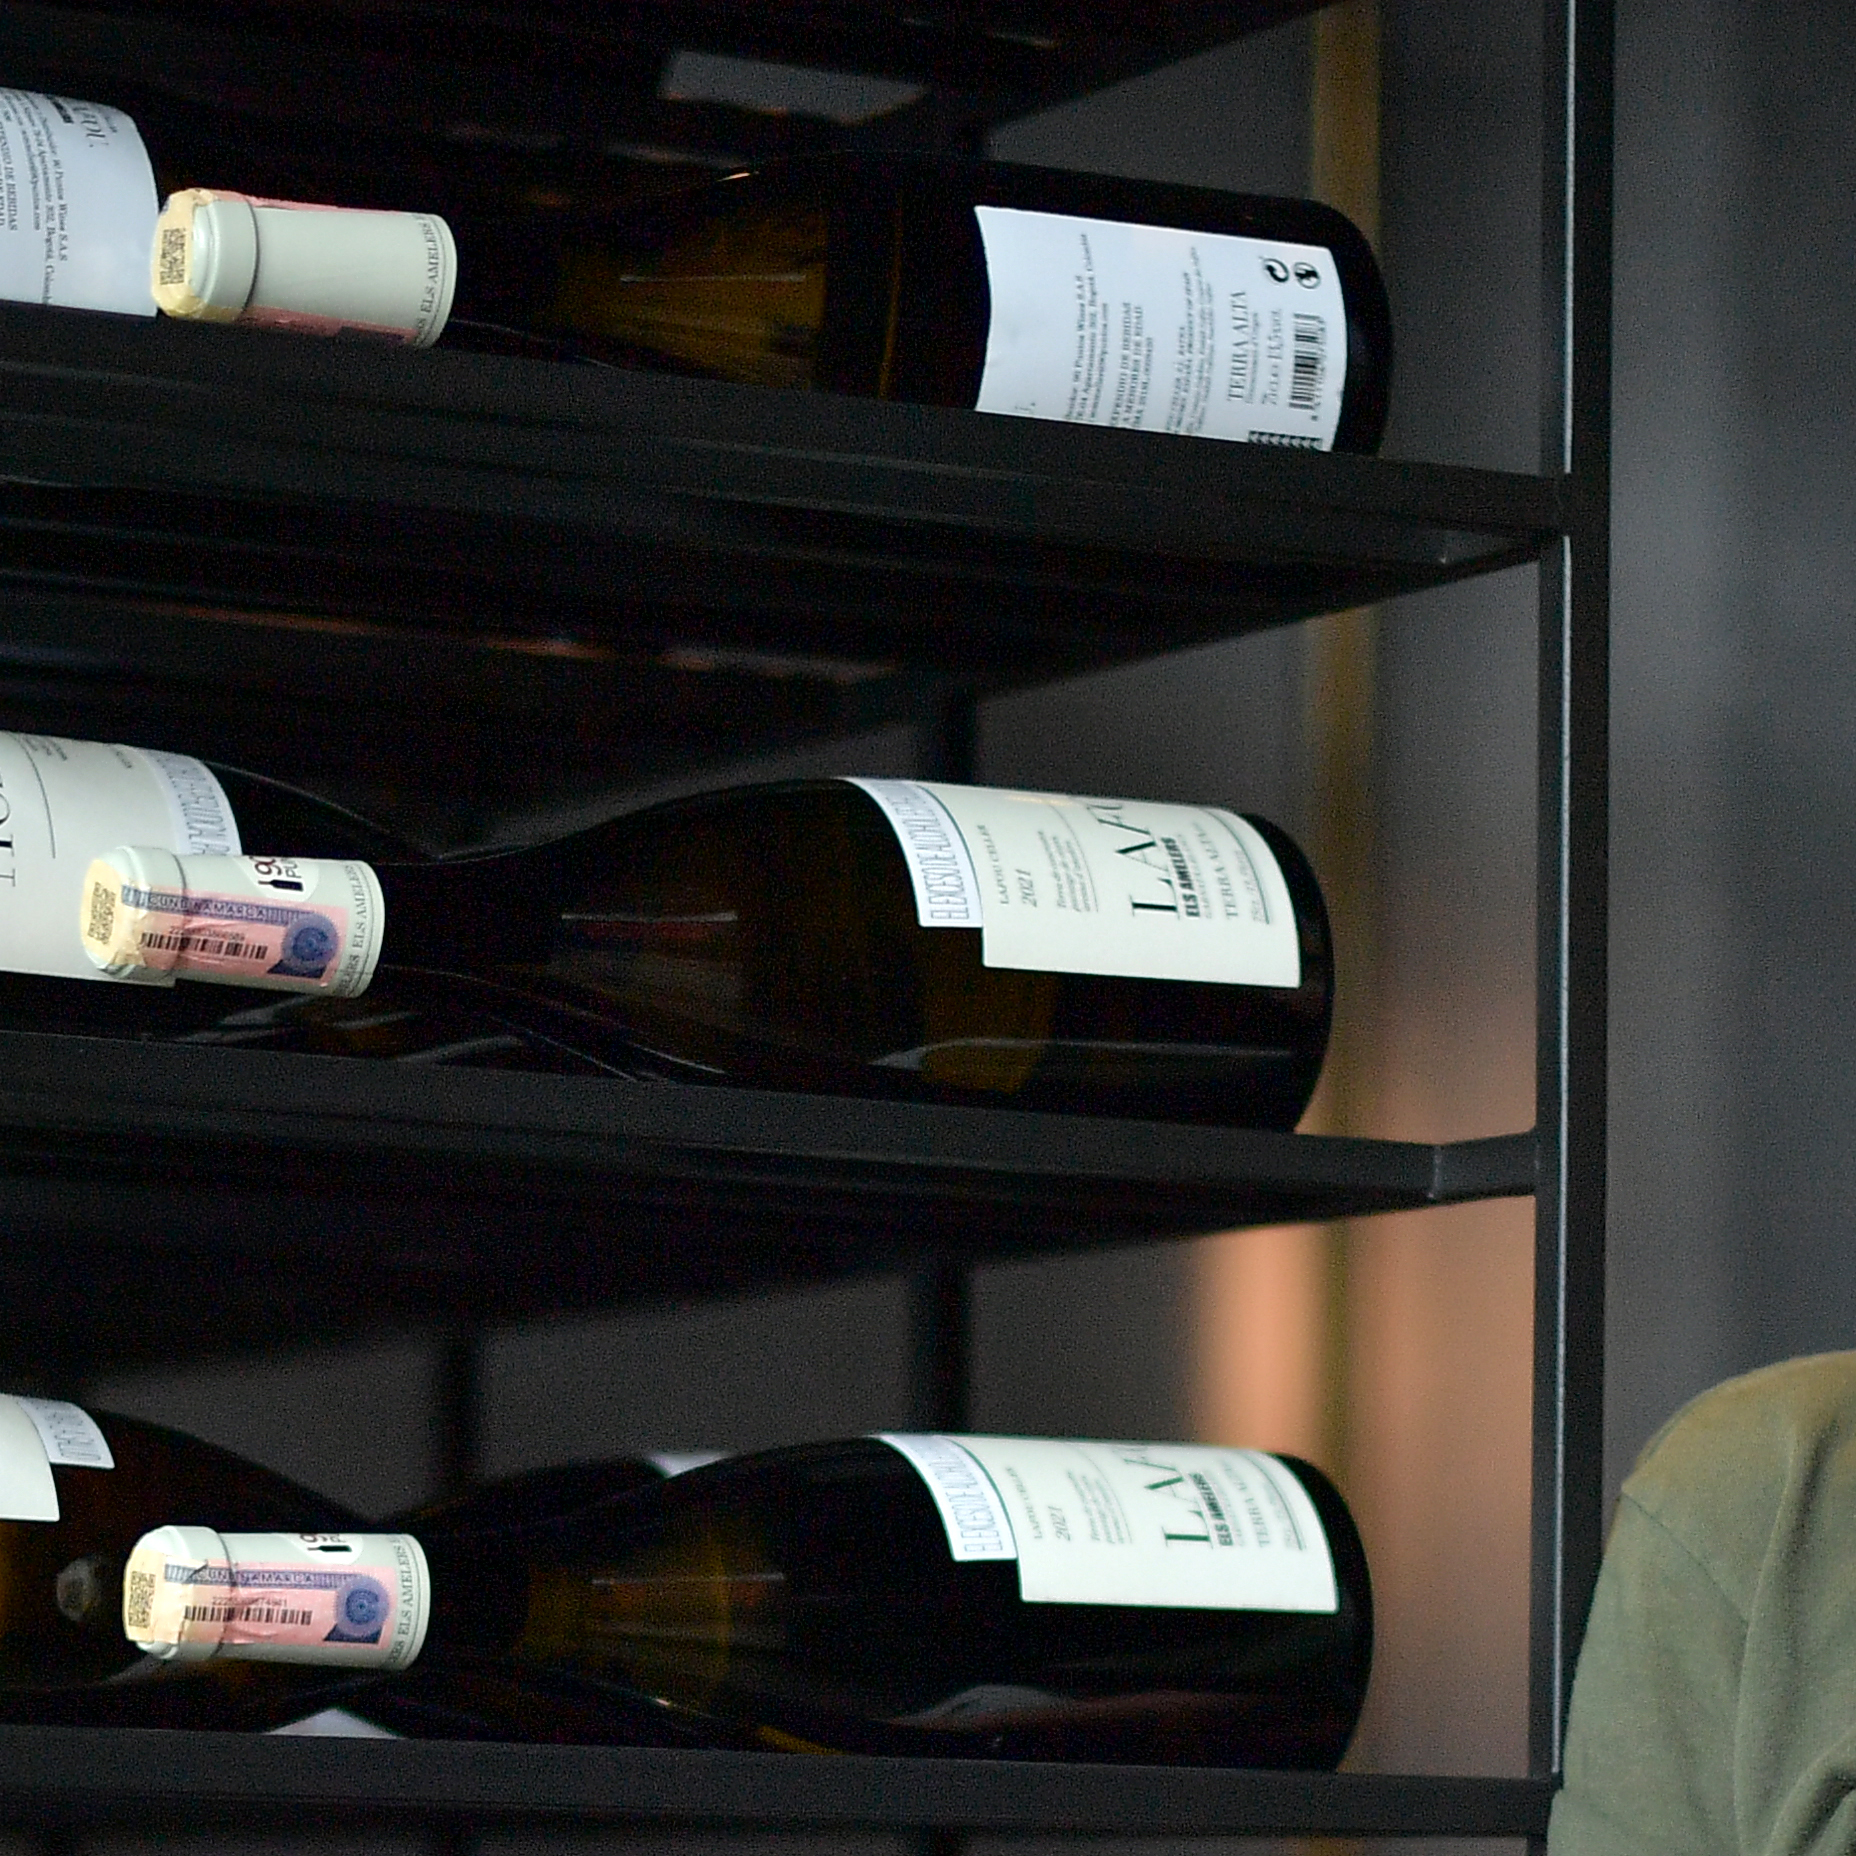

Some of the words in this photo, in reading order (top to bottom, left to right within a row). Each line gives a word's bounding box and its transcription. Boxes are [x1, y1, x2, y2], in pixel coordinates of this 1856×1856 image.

[1229, 291, 1249, 335] ALTA
[1225, 341, 1249, 402] TERRA
[922, 868, 967, 906] EXCESO
[1014, 868, 1037, 908] 2021
[1213, 866, 1240, 920] TERRA
[1181, 893, 1201, 919] ELS
[351, 921, 367, 949] ELS
[1047, 1505, 1071, 1542] 2021
[1217, 1523, 1234, 1547] ELS
[396, 1610, 412, 1636] ELS
